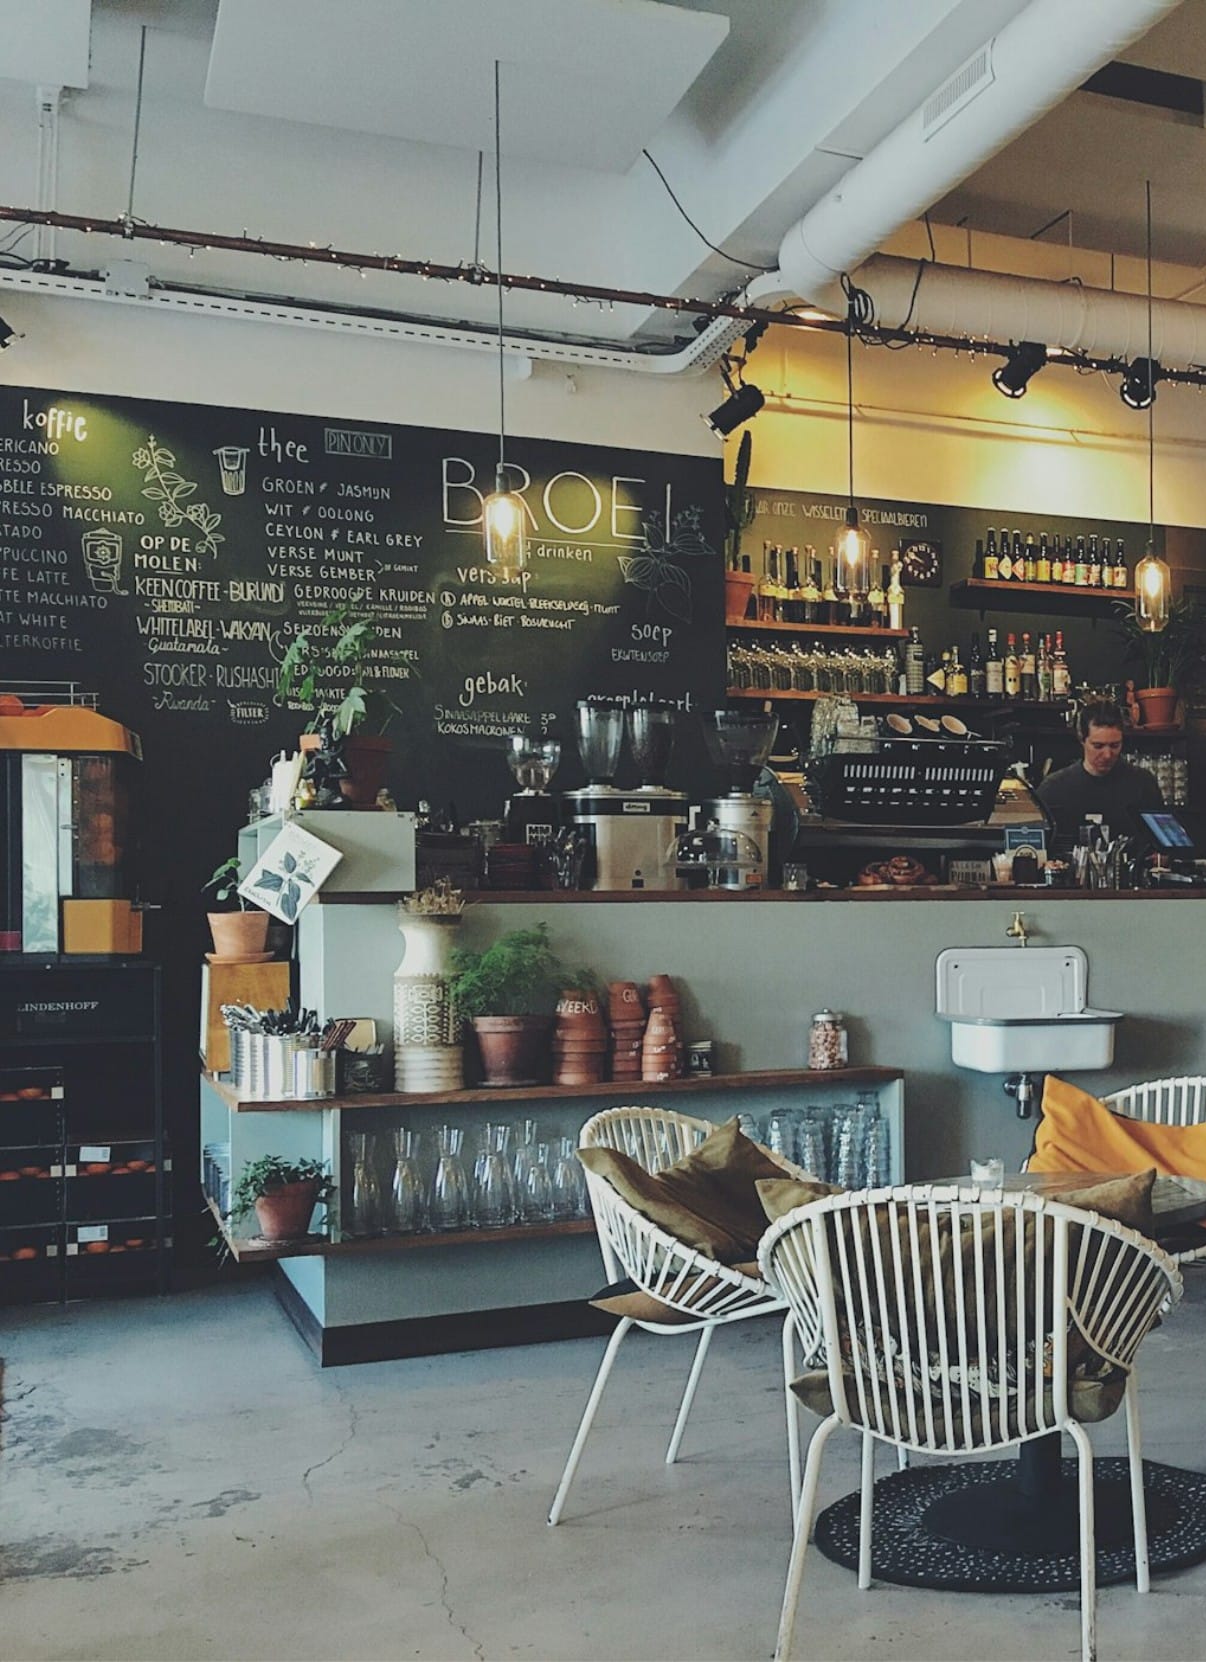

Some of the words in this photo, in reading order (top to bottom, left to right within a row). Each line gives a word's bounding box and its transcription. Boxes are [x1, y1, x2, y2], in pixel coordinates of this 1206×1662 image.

[23, 399, 87, 441] koffie
[257, 427, 309, 463] thee
[328, 431, 351, 451] PIN
[353, 434, 386, 455] ONLY
[0, 479, 34, 495] BELE
[41, 482, 112, 501] ESPRESSO
[262, 476, 315, 495] GROEN
[0, 501, 52, 518] RESSO
[63, 505, 145, 525] MACCHIATO
[265, 503, 293, 517] WIT
[318, 506, 374, 522] OOLONG
[802, 504, 847, 522] WISSELEN
[0, 524, 42, 539] TADO
[265, 522, 324, 541] CEYLON
[347, 530, 380, 545] EARL
[386, 534, 423, 548] GREY
[140, 535, 165, 550] OP
[170, 536, 191, 552] DE
[267, 547, 317, 560] VERSE
[324, 549, 364, 563] MUNT
[537, 546, 592, 562] drinken
[0, 566, 20, 581] FE
[27, 570, 70, 585] LATTE
[267, 563, 313, 578] VERSE
[320, 565, 376, 582] GEMBER
[27, 592, 108, 609] MACCHIATO
[229, 580, 284, 603] BURUNDI
[294, 584, 373, 600] GEDROOGDE
[379, 588, 436, 604] KRUIDEN
[19, 613, 68, 629] WHITE
[493, 614, 516, 627] BIET
[631, 624, 673, 647] soep
[143, 662, 208, 687] STOOKER
[236, 706, 264, 719] FILTER
